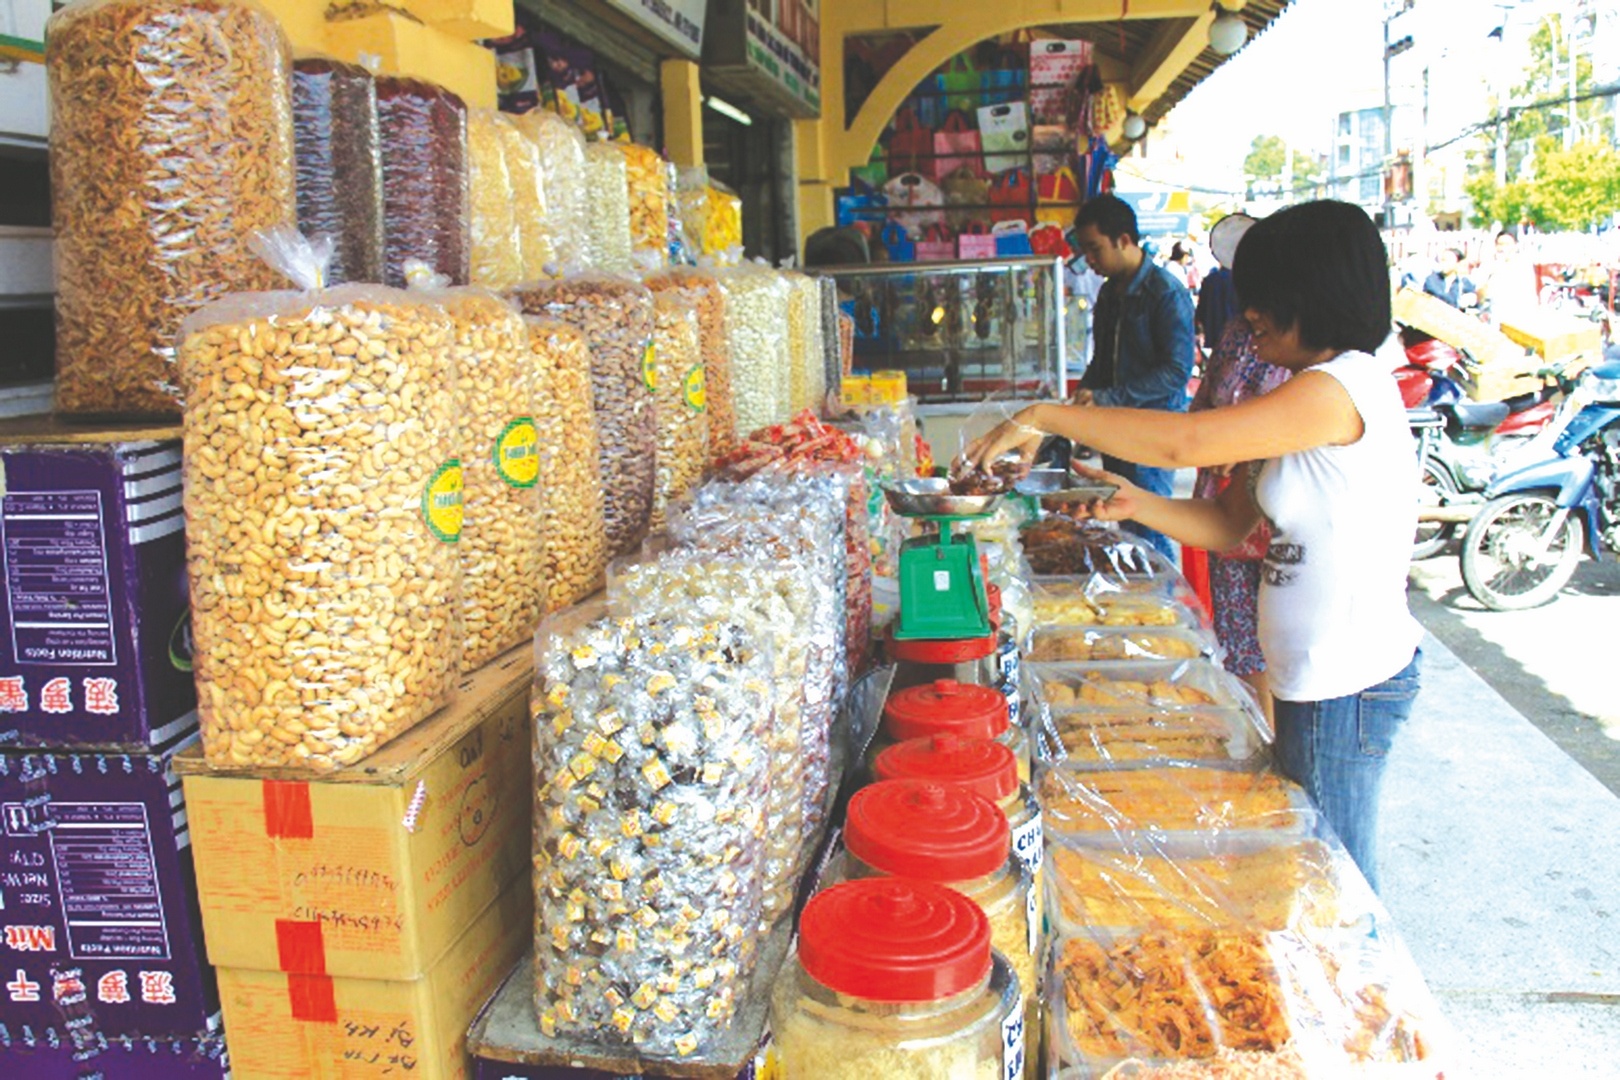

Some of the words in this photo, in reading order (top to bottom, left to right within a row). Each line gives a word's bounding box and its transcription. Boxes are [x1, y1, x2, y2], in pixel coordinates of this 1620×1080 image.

[25, 647, 55, 659] Facts
[58, 648, 107, 659] Nutrition
[22, 872, 48, 886] Net
[20, 893, 51, 906] Size:
